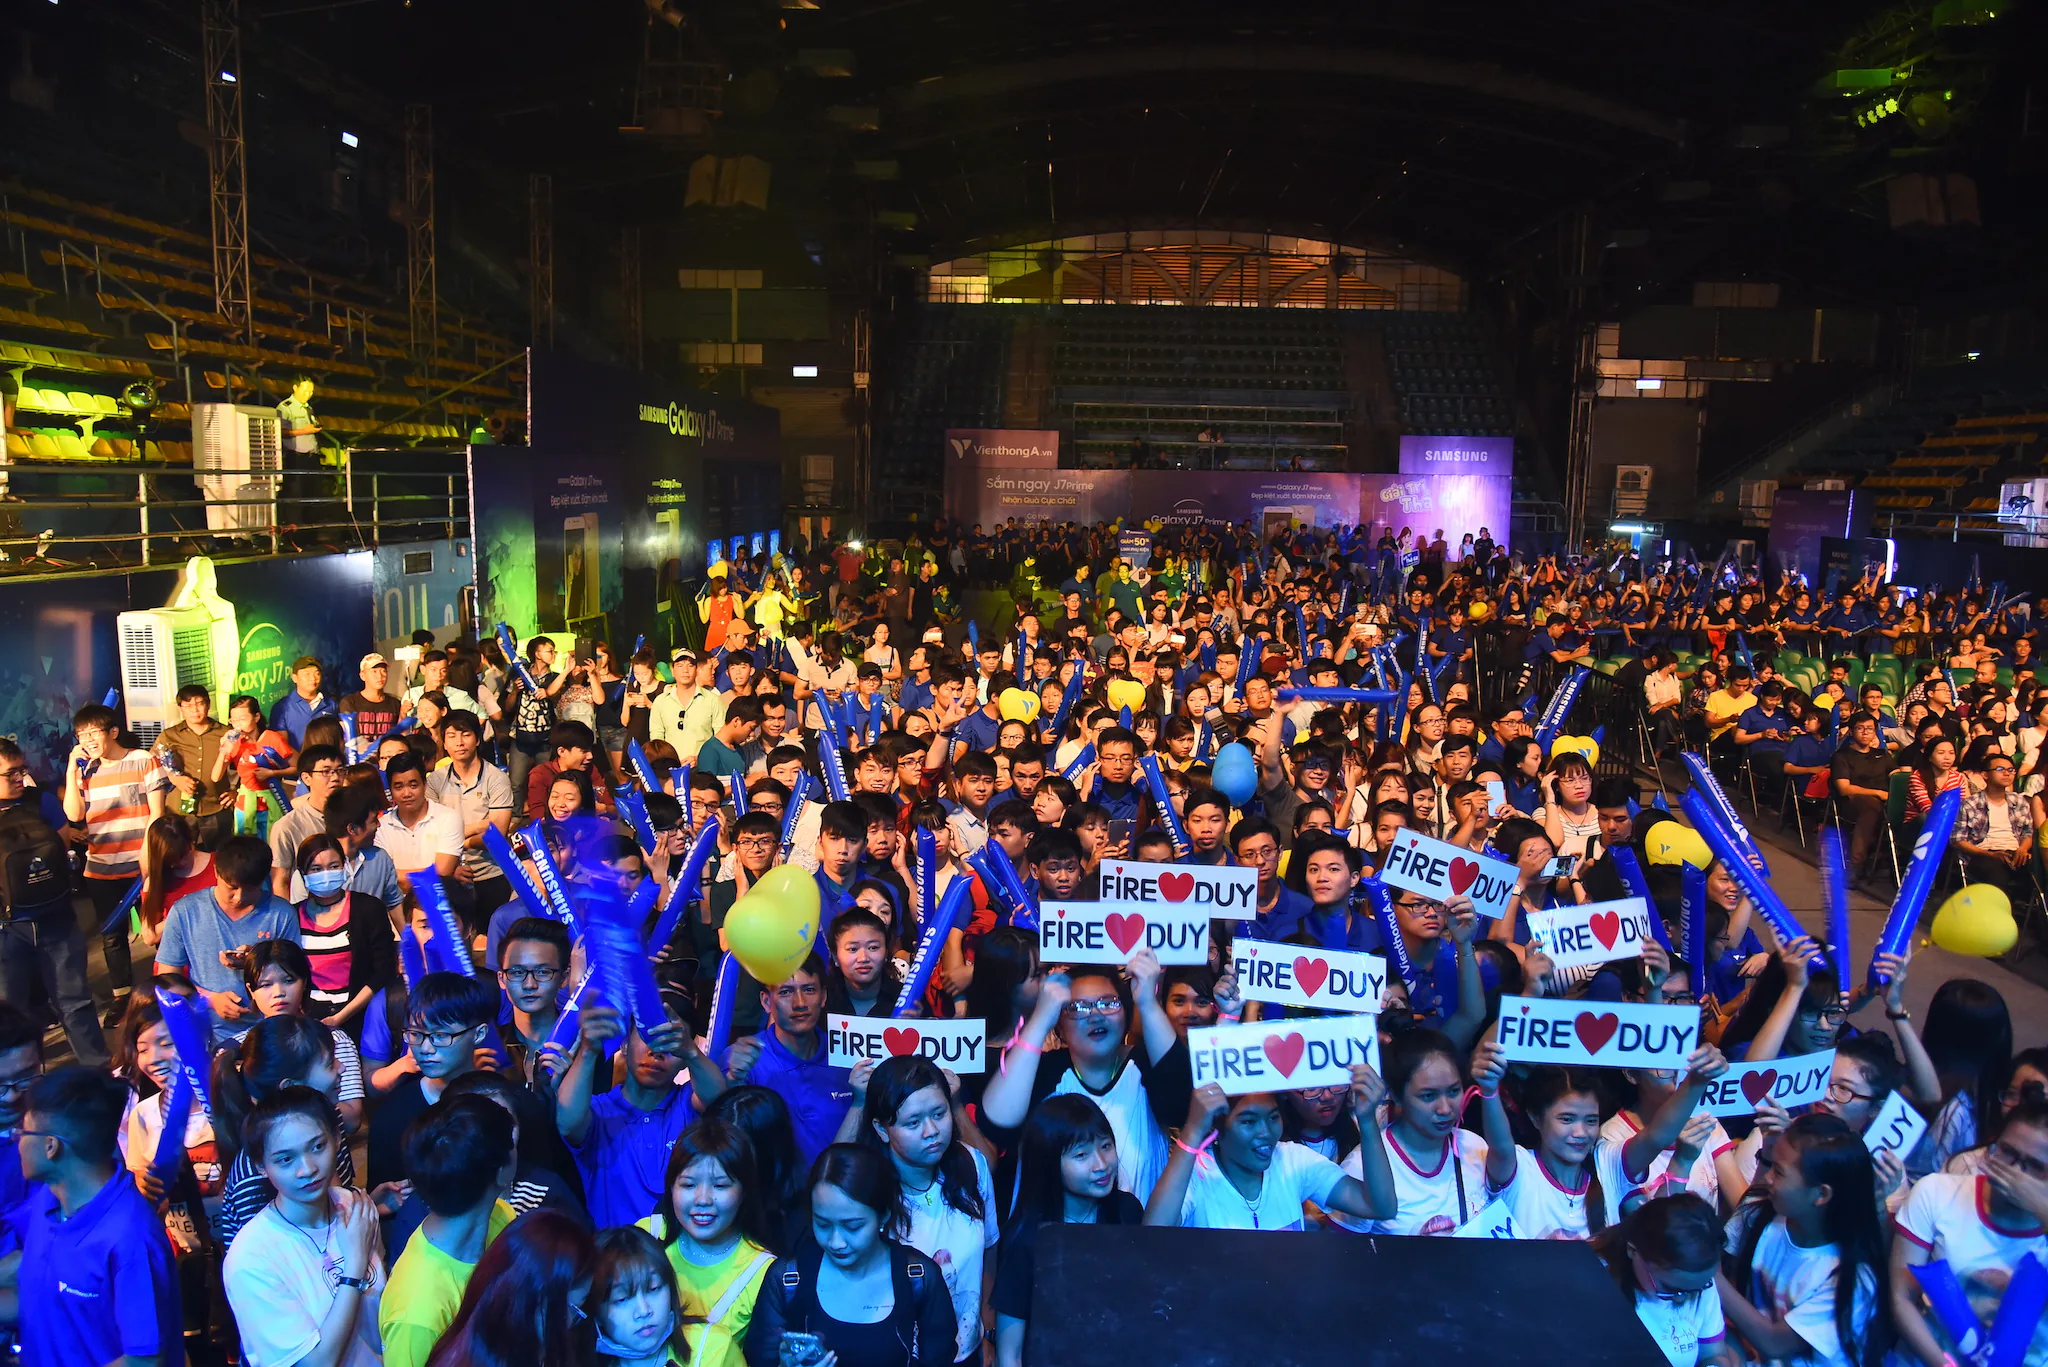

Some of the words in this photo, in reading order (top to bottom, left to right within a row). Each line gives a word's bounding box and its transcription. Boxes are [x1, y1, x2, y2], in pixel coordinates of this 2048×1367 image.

[639, 403, 668, 425] SAMSUNG
[668, 400, 706, 447] Galaxy
[707, 409, 717, 439] J7
[1425, 450, 1488, 462] SAMSUNG
[986, 475, 1015, 489] Sắm
[1018, 479, 1050, 492] ngay
[1276, 483, 1300, 491] Galaxy
[1150, 515, 1193, 529] Galaxy
[1193, 516, 1204, 525] J7
[246, 646, 281, 663] SAMSUNG
[232, 667, 268, 693] laxy
[269, 661, 284, 685] J7
[1551, 681, 1578, 725] SAMSUNG
[358, 723, 375, 734] YOU
[833, 749, 854, 802] AMSUNG
[1155, 800, 1181, 851] SAMSU
[532, 849, 575, 925] SAMSUNG
[917, 855, 925, 924] SAMSUNG
[1103, 875, 1158, 902] FIRE
[1195, 881, 1256, 907] DUY
[1387, 844, 1449, 887] FIRE
[1472, 873, 1513, 906] DUY
[1042, 920, 1104, 949] FIRE
[1146, 923, 1207, 949] DUY
[896, 927, 937, 1008] SAMSUNG
[1235, 957, 1293, 991] FIRE
[1329, 968, 1384, 1001] DUY
[829, 1029, 883, 1058] FIRE
[920, 1036, 983, 1062] DUY
[1502, 1016, 1574, 1048] FIRE
[1618, 1023, 1694, 1055] DUY
[1195, 1045, 1265, 1080] FIRE
[1307, 1036, 1374, 1071] DUY
[1700, 1079, 1740, 1106] RE
[1774, 1065, 1831, 1099] DUY
